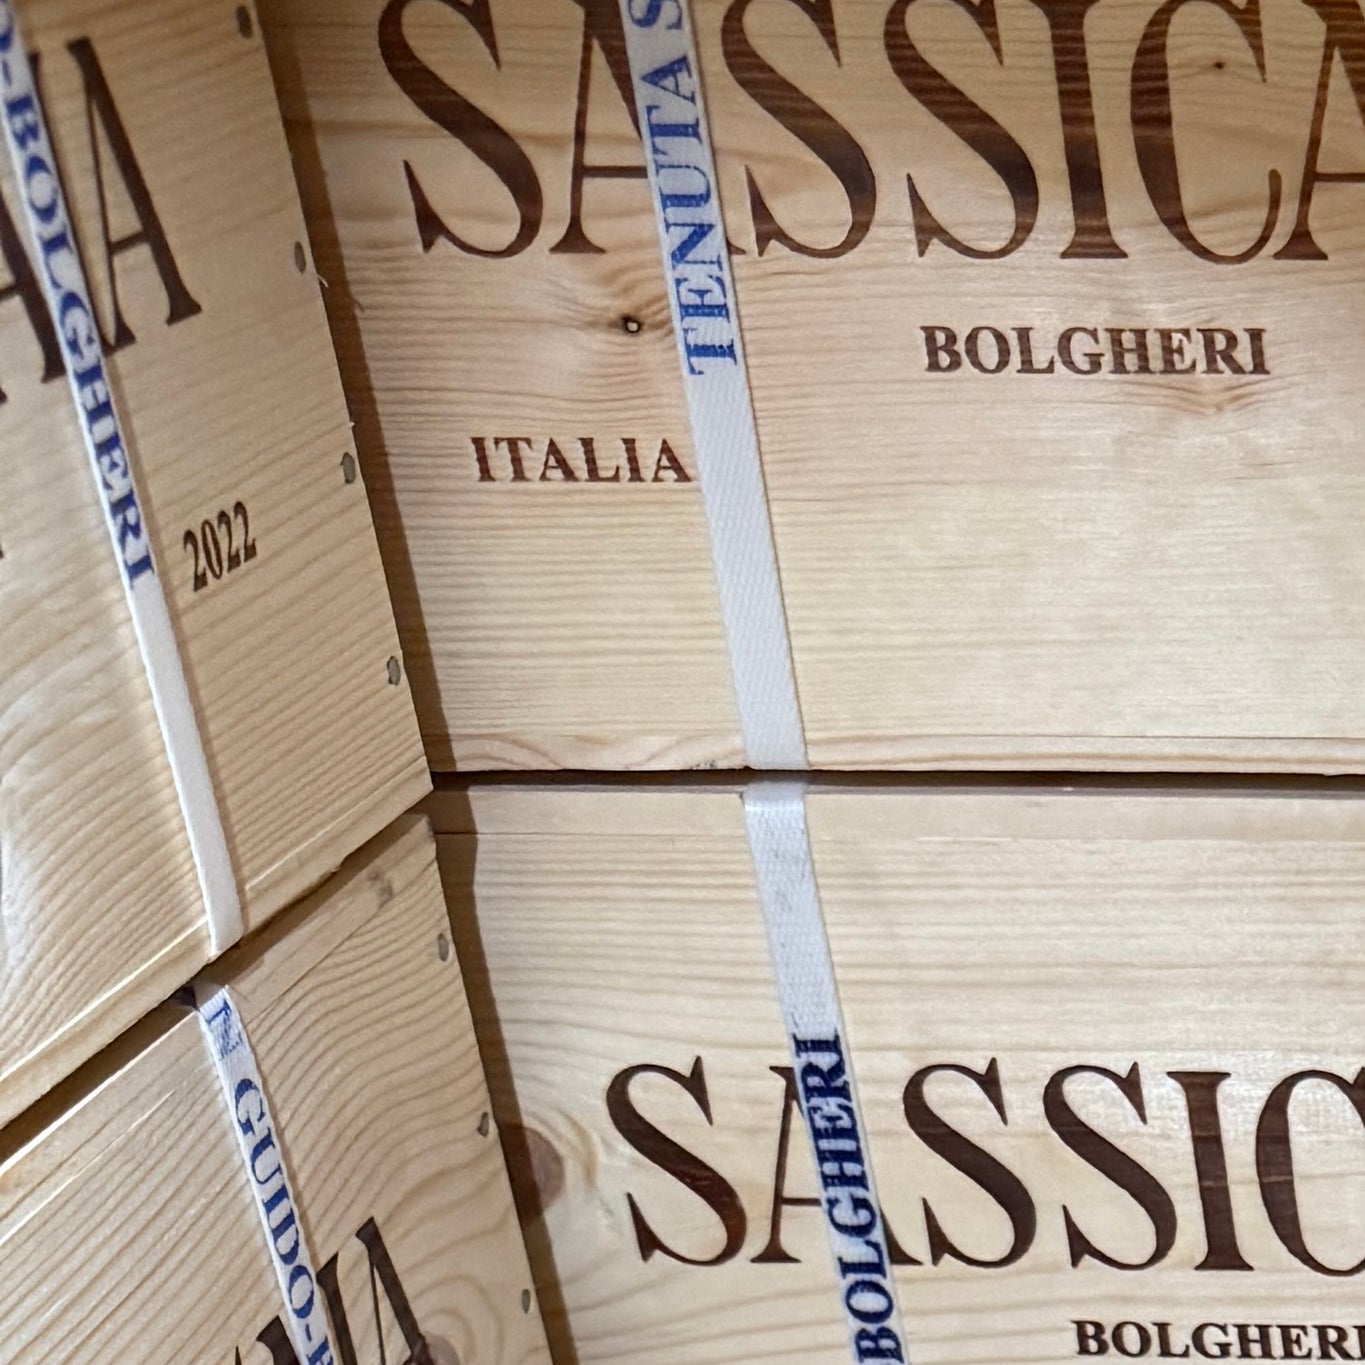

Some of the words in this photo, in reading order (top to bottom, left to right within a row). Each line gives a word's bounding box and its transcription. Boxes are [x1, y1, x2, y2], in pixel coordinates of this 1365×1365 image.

[640, 54, 738, 375] TENUTA
[919, 325, 1271, 375] BOLGHERI
[470, 437, 694, 484] ITALIA
[183, 501, 257, 592] 2022
